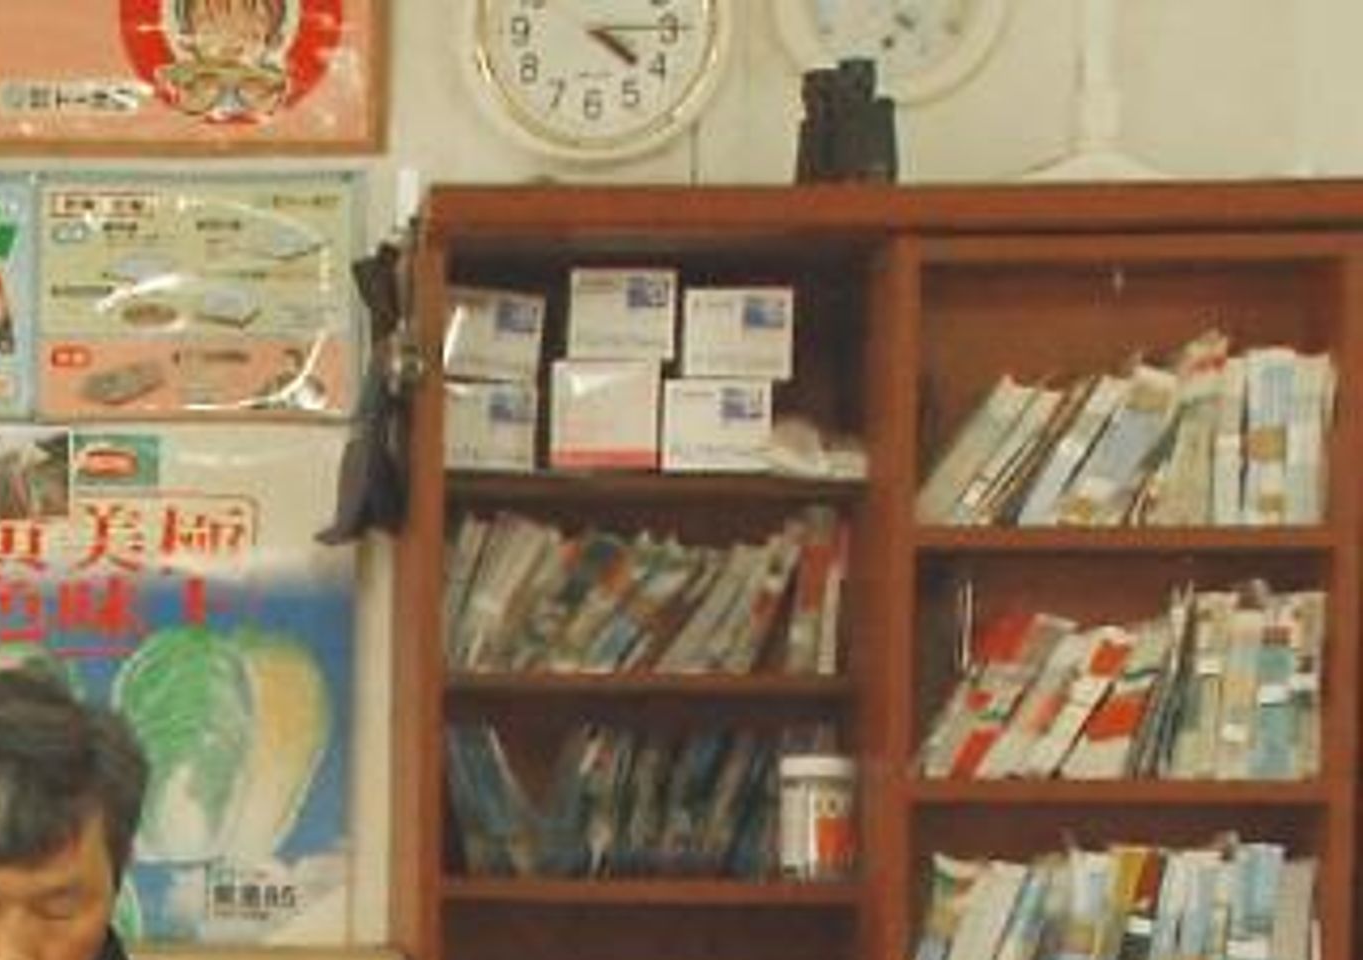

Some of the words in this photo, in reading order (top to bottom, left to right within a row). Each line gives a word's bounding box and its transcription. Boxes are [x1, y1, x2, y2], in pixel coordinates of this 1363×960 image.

[511, 16, 530, 46] 9
[519, 53, 538, 83] 8
[647, 52, 667, 81] 4
[547, 77, 565, 108] 7
[583, 88, 603, 120] 6
[620, 79, 640, 108] 5
